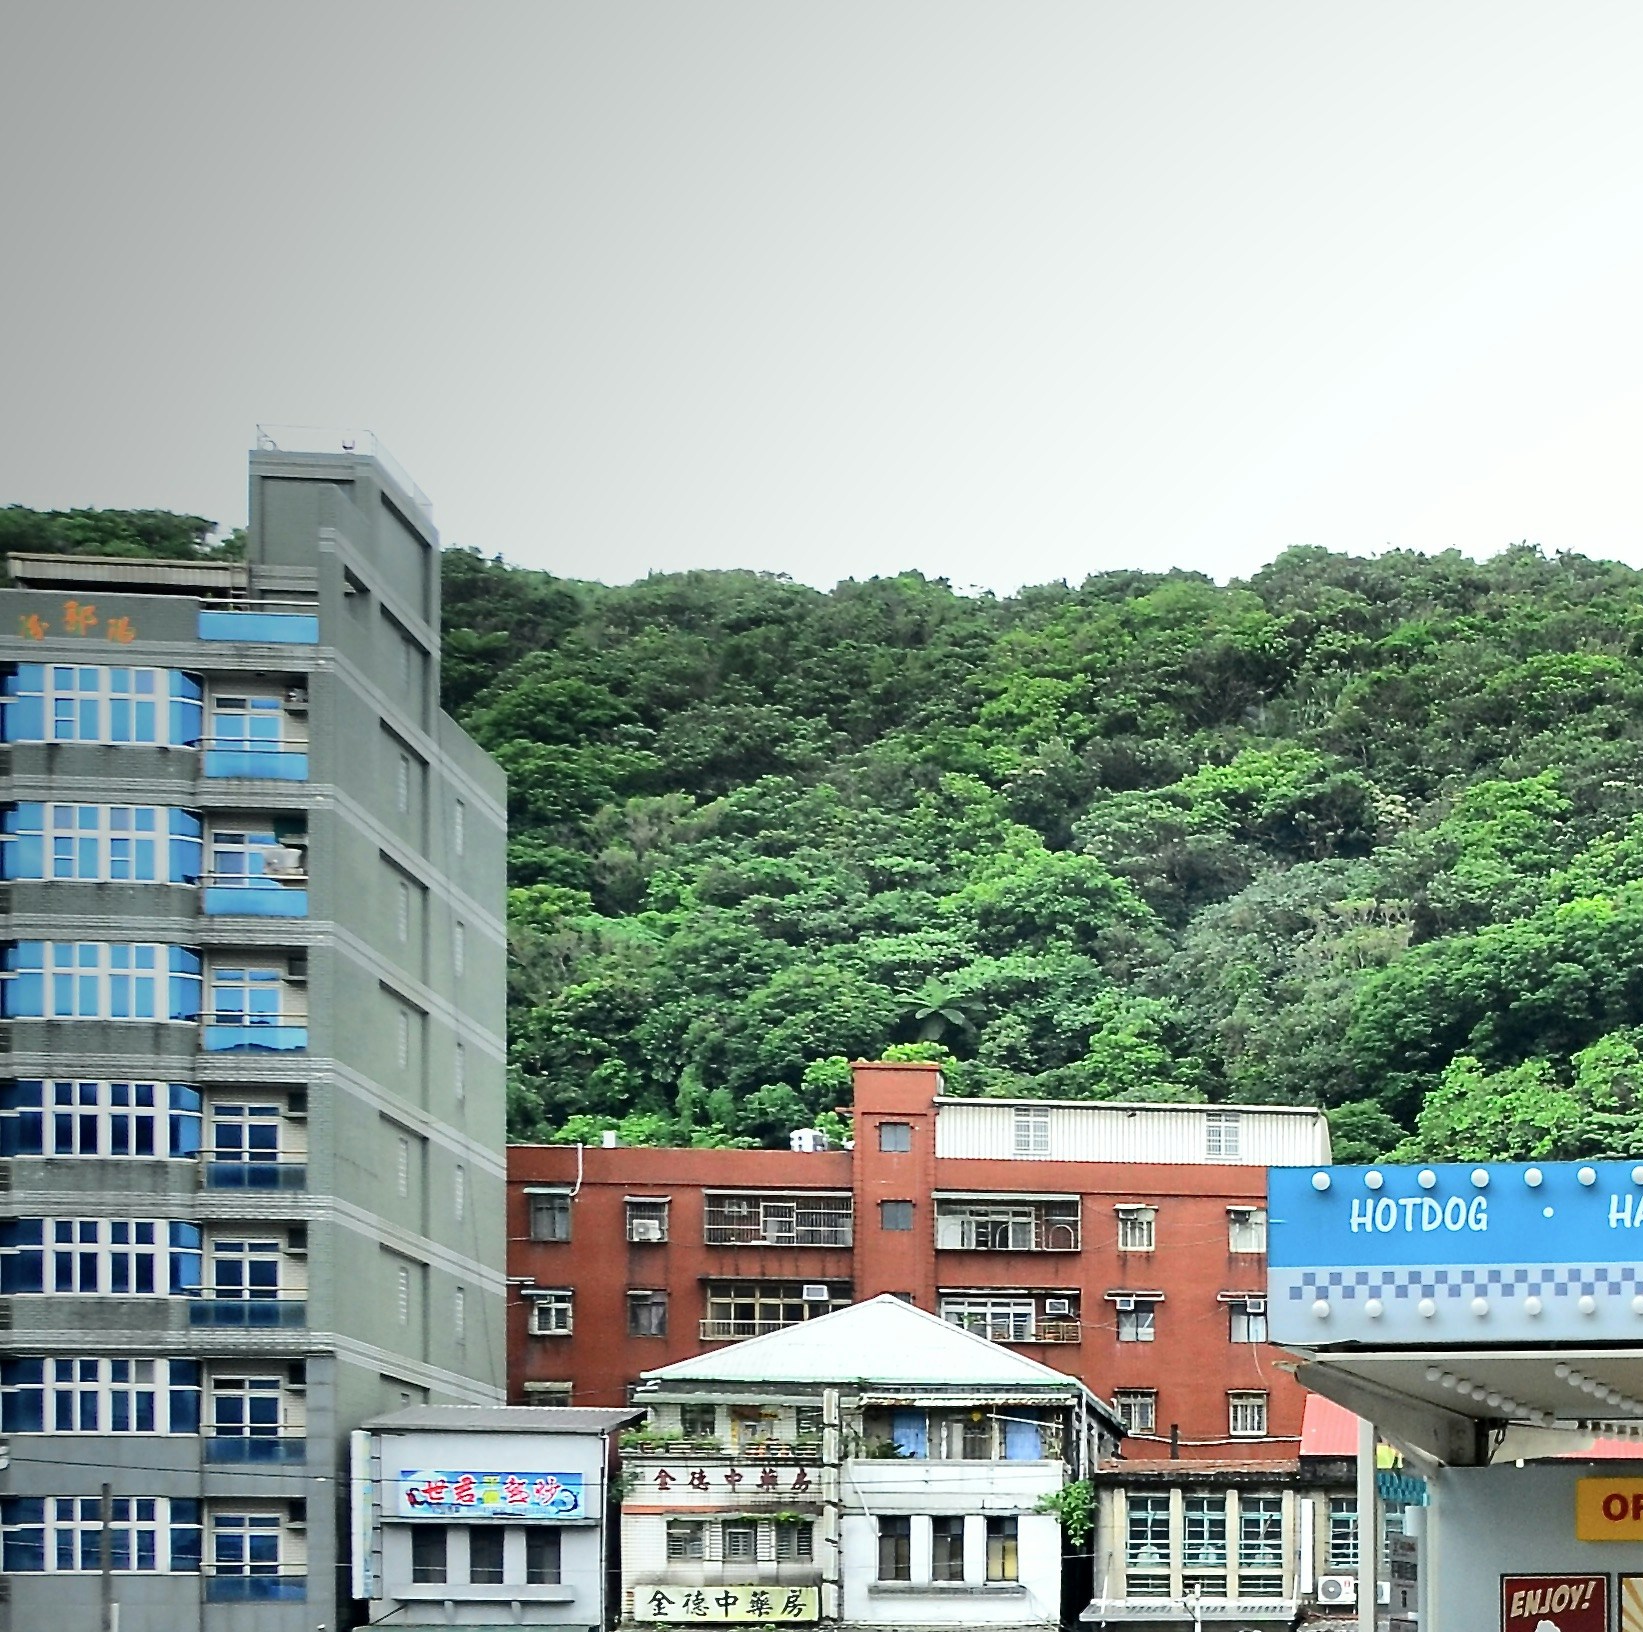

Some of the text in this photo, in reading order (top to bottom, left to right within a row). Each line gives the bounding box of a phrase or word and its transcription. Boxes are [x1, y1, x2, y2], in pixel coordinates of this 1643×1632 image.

[1349, 1193, 1488, 1234] HOTDOG
[647, 1589, 807, 1618] 金德中藥房
[1510, 1581, 1597, 1618] ENJOY!
